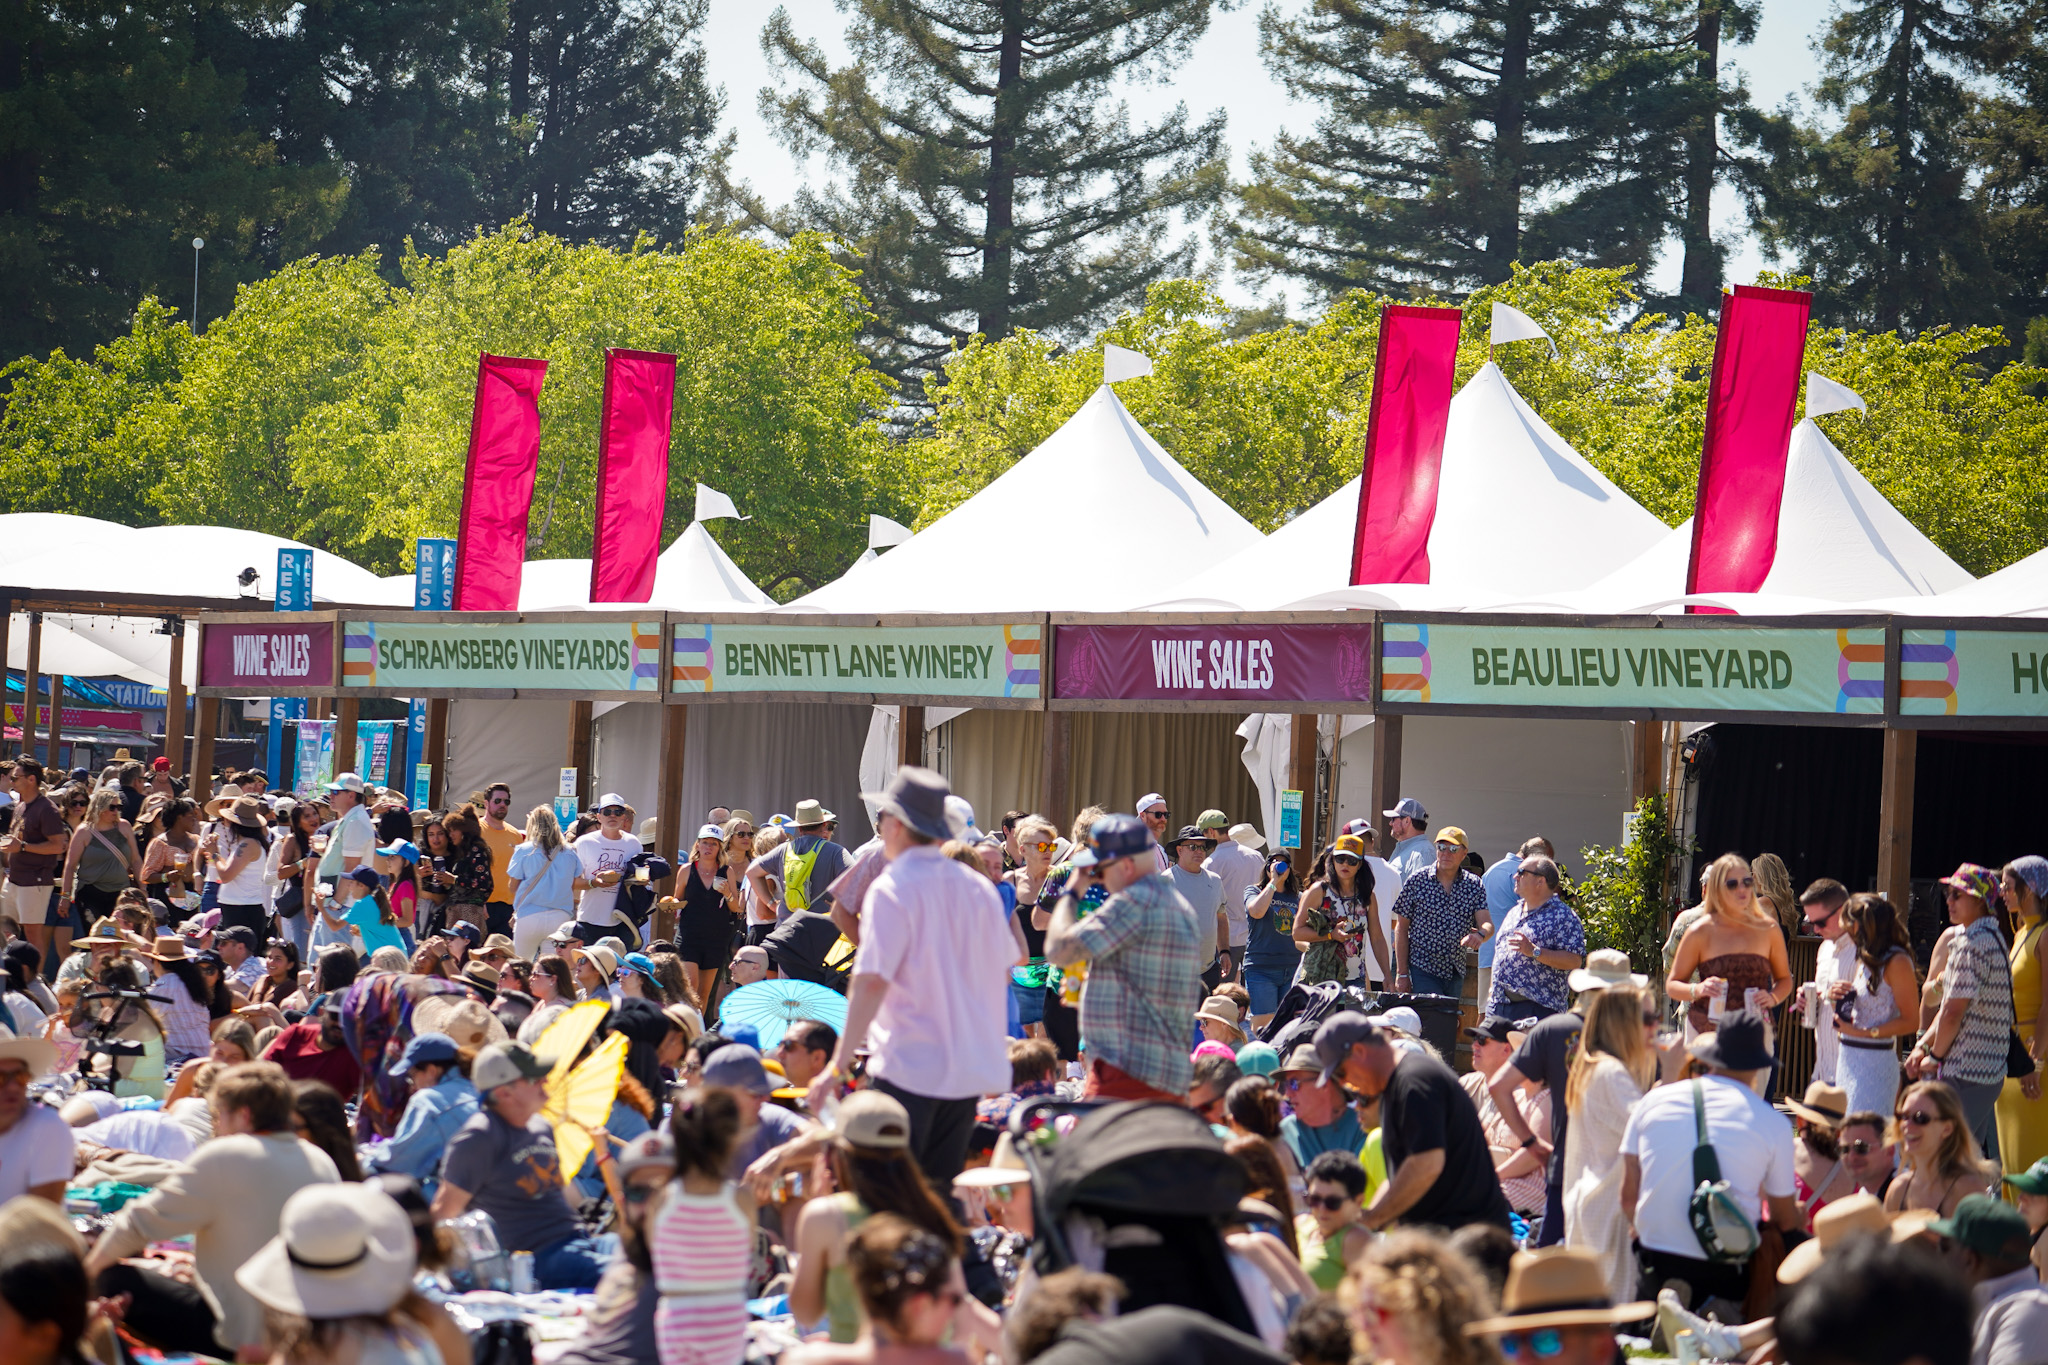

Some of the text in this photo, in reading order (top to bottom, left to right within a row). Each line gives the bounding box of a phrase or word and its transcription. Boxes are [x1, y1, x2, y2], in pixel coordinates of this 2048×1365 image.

[233, 634, 310, 677] WINE SALES
[379, 639, 629, 671] SCHRAMSBERG VINEYARDS
[725, 644, 993, 679] BENNETT LANE WINERY
[1151, 639, 1274, 690] WINE SALES
[1472, 647, 1793, 690] BEAULIEU VINEYARD
